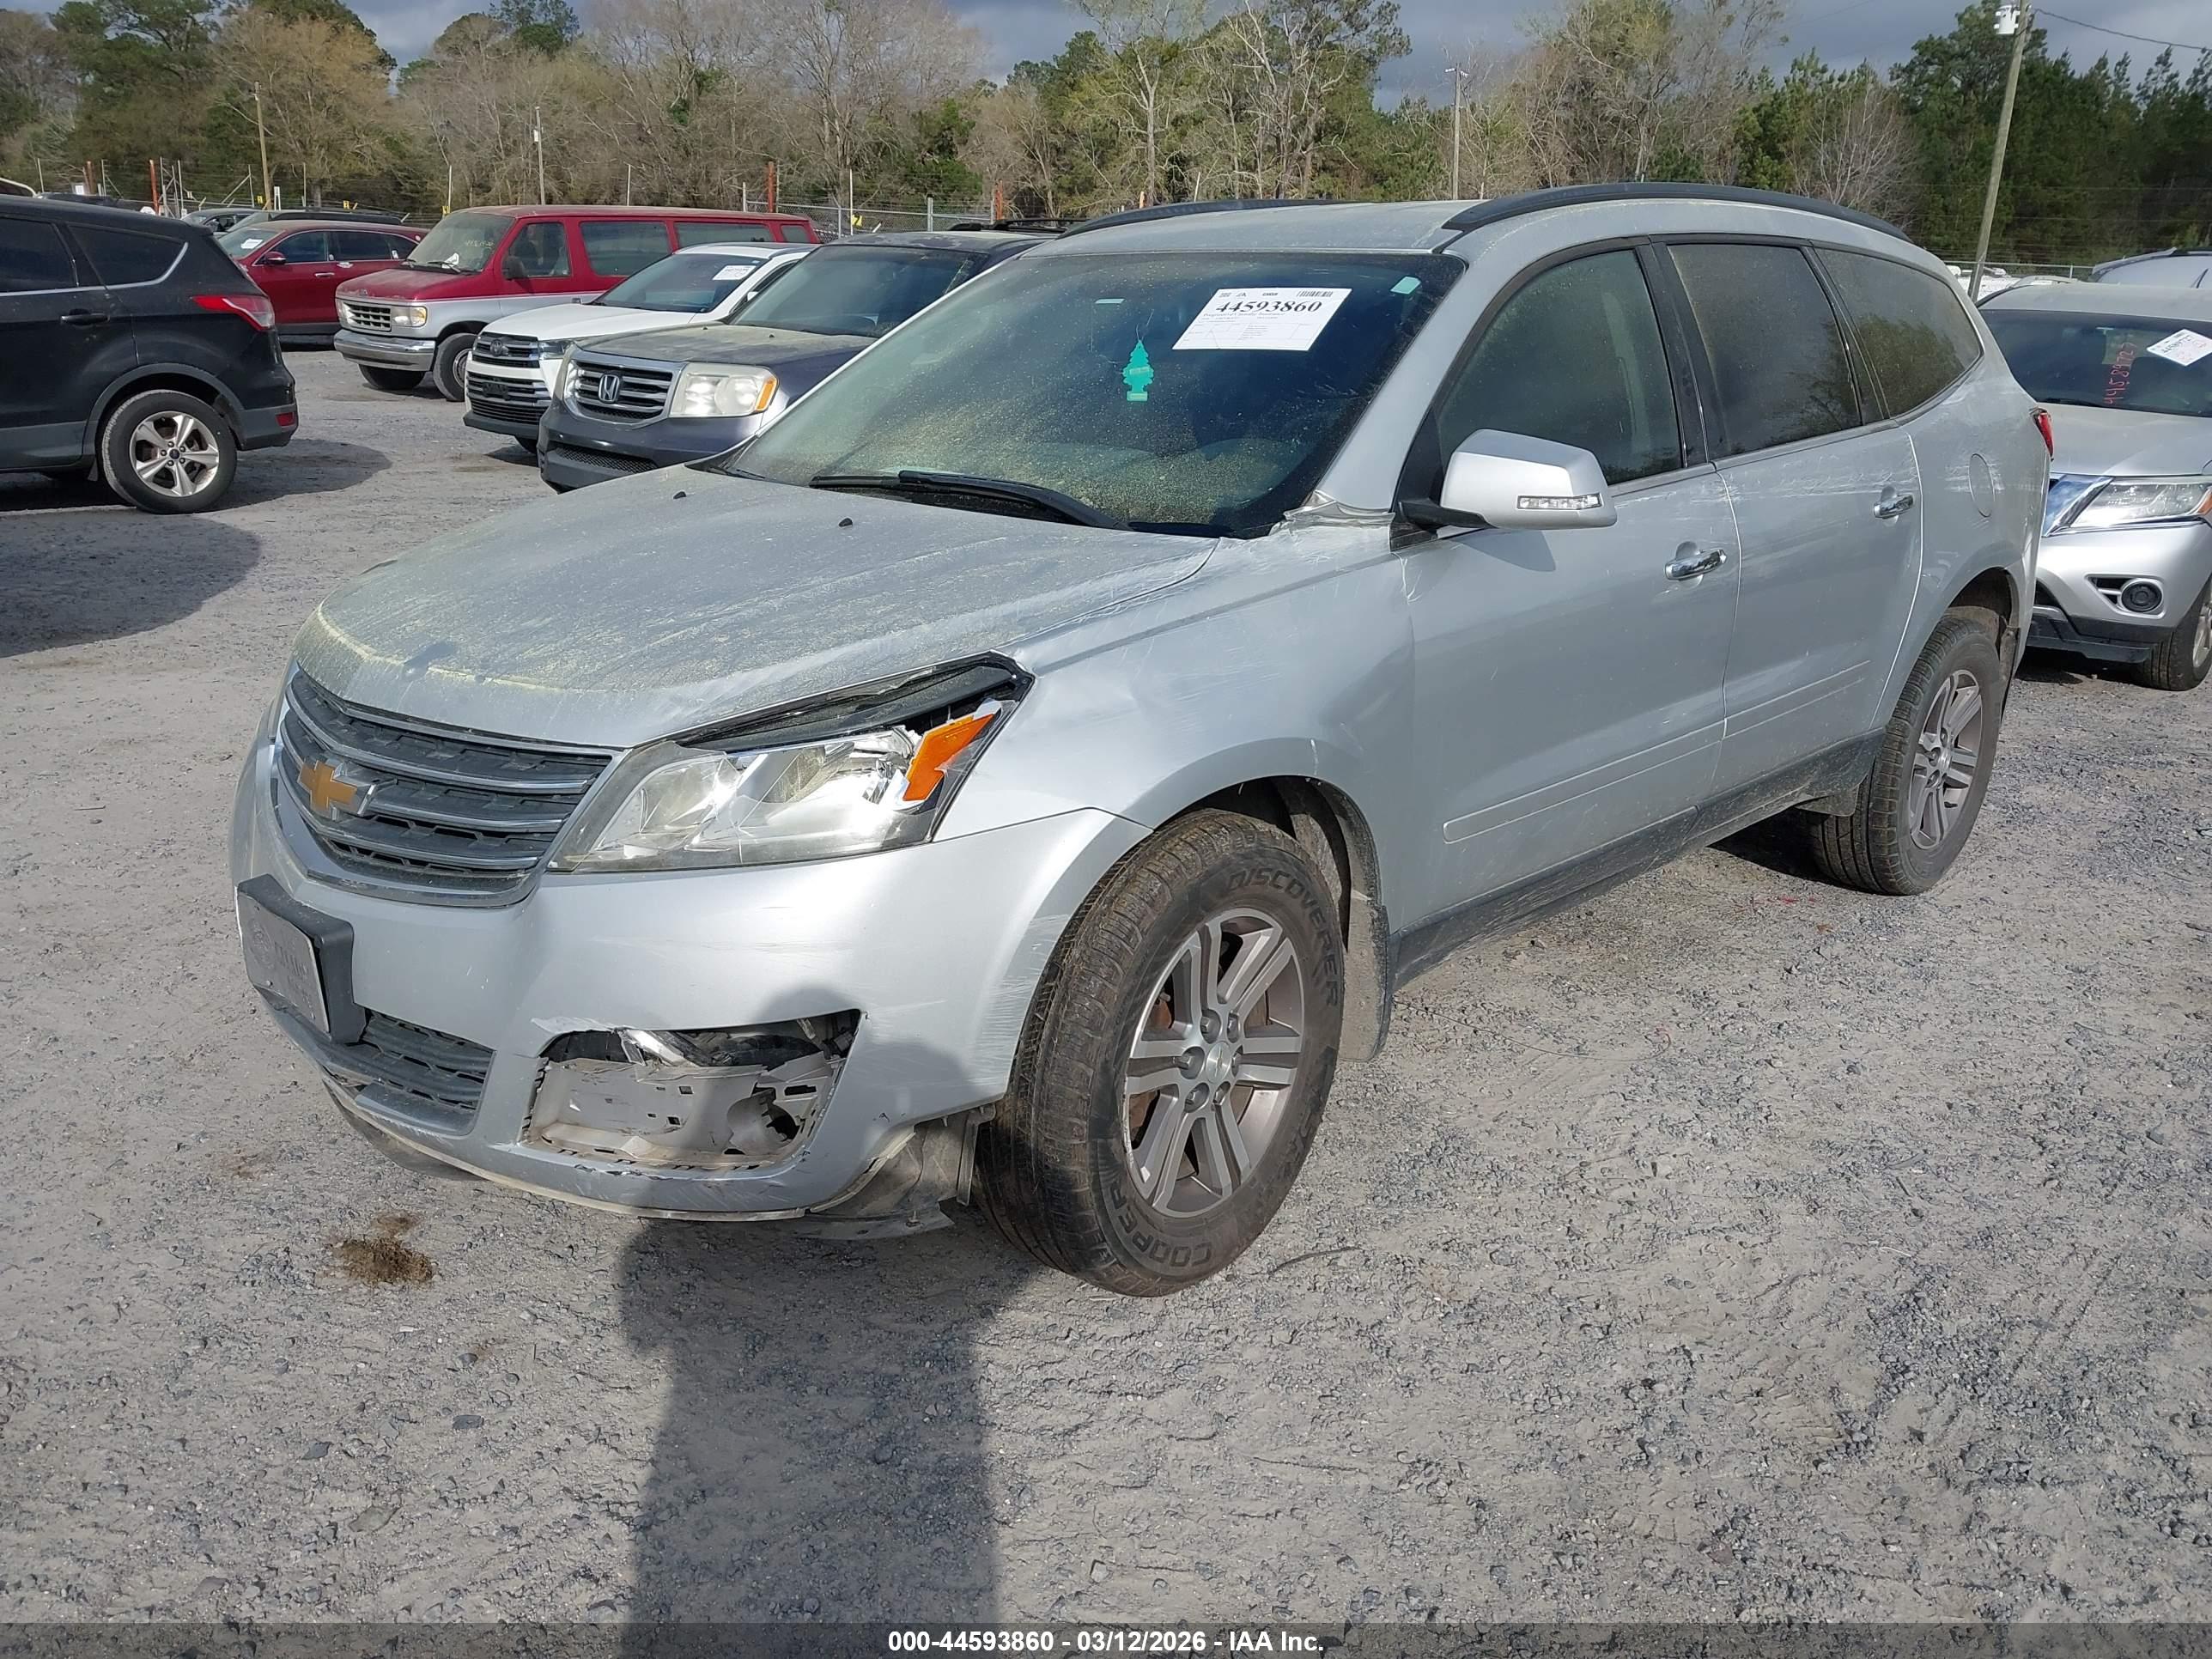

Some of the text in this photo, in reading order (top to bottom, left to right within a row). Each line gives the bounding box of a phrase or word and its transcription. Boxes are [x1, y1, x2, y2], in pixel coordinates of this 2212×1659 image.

[1216, 301, 1322, 312] 44593860
[1228, 867, 1339, 1006] DISCOVERER
[1110, 1182, 1212, 1267] COOPER
